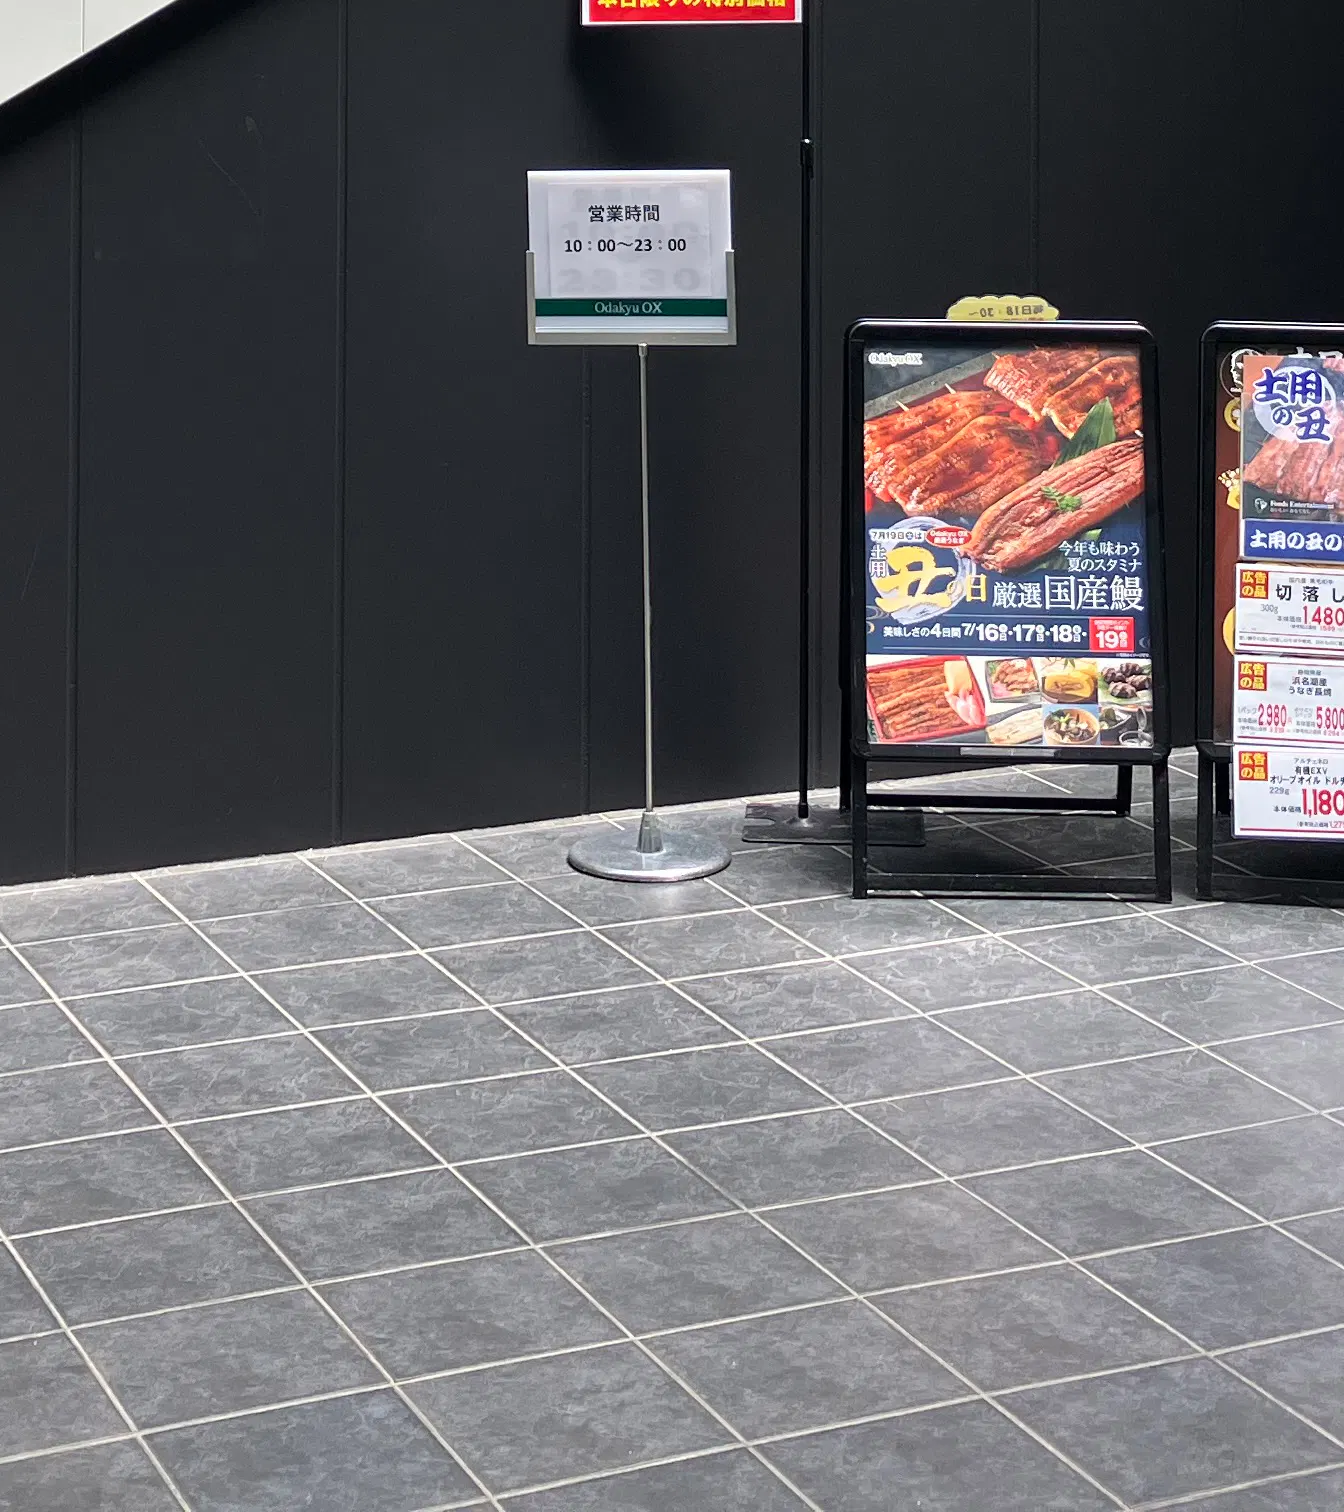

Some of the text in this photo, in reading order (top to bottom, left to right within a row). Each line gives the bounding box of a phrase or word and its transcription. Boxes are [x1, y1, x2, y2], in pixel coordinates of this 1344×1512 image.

[588, 204, 660, 223] 営業時間
[594, 301, 662, 316] Odakyu OX
[1254, 368, 1324, 405] 土用
[1058, 540, 1140, 557] 今年も味わう
[1067, 557, 1142, 572] 夏のスタミナ
[1242, 571, 1267, 584] 広告
[992, 574, 1145, 612] 厳選国産鰻
[1241, 585, 1266, 598] の品
[1240, 662, 1265, 676] 広告
[1240, 677, 1265, 690] の品
[1241, 753, 1266, 765] 広告
[1240, 767, 1266, 780] の品
